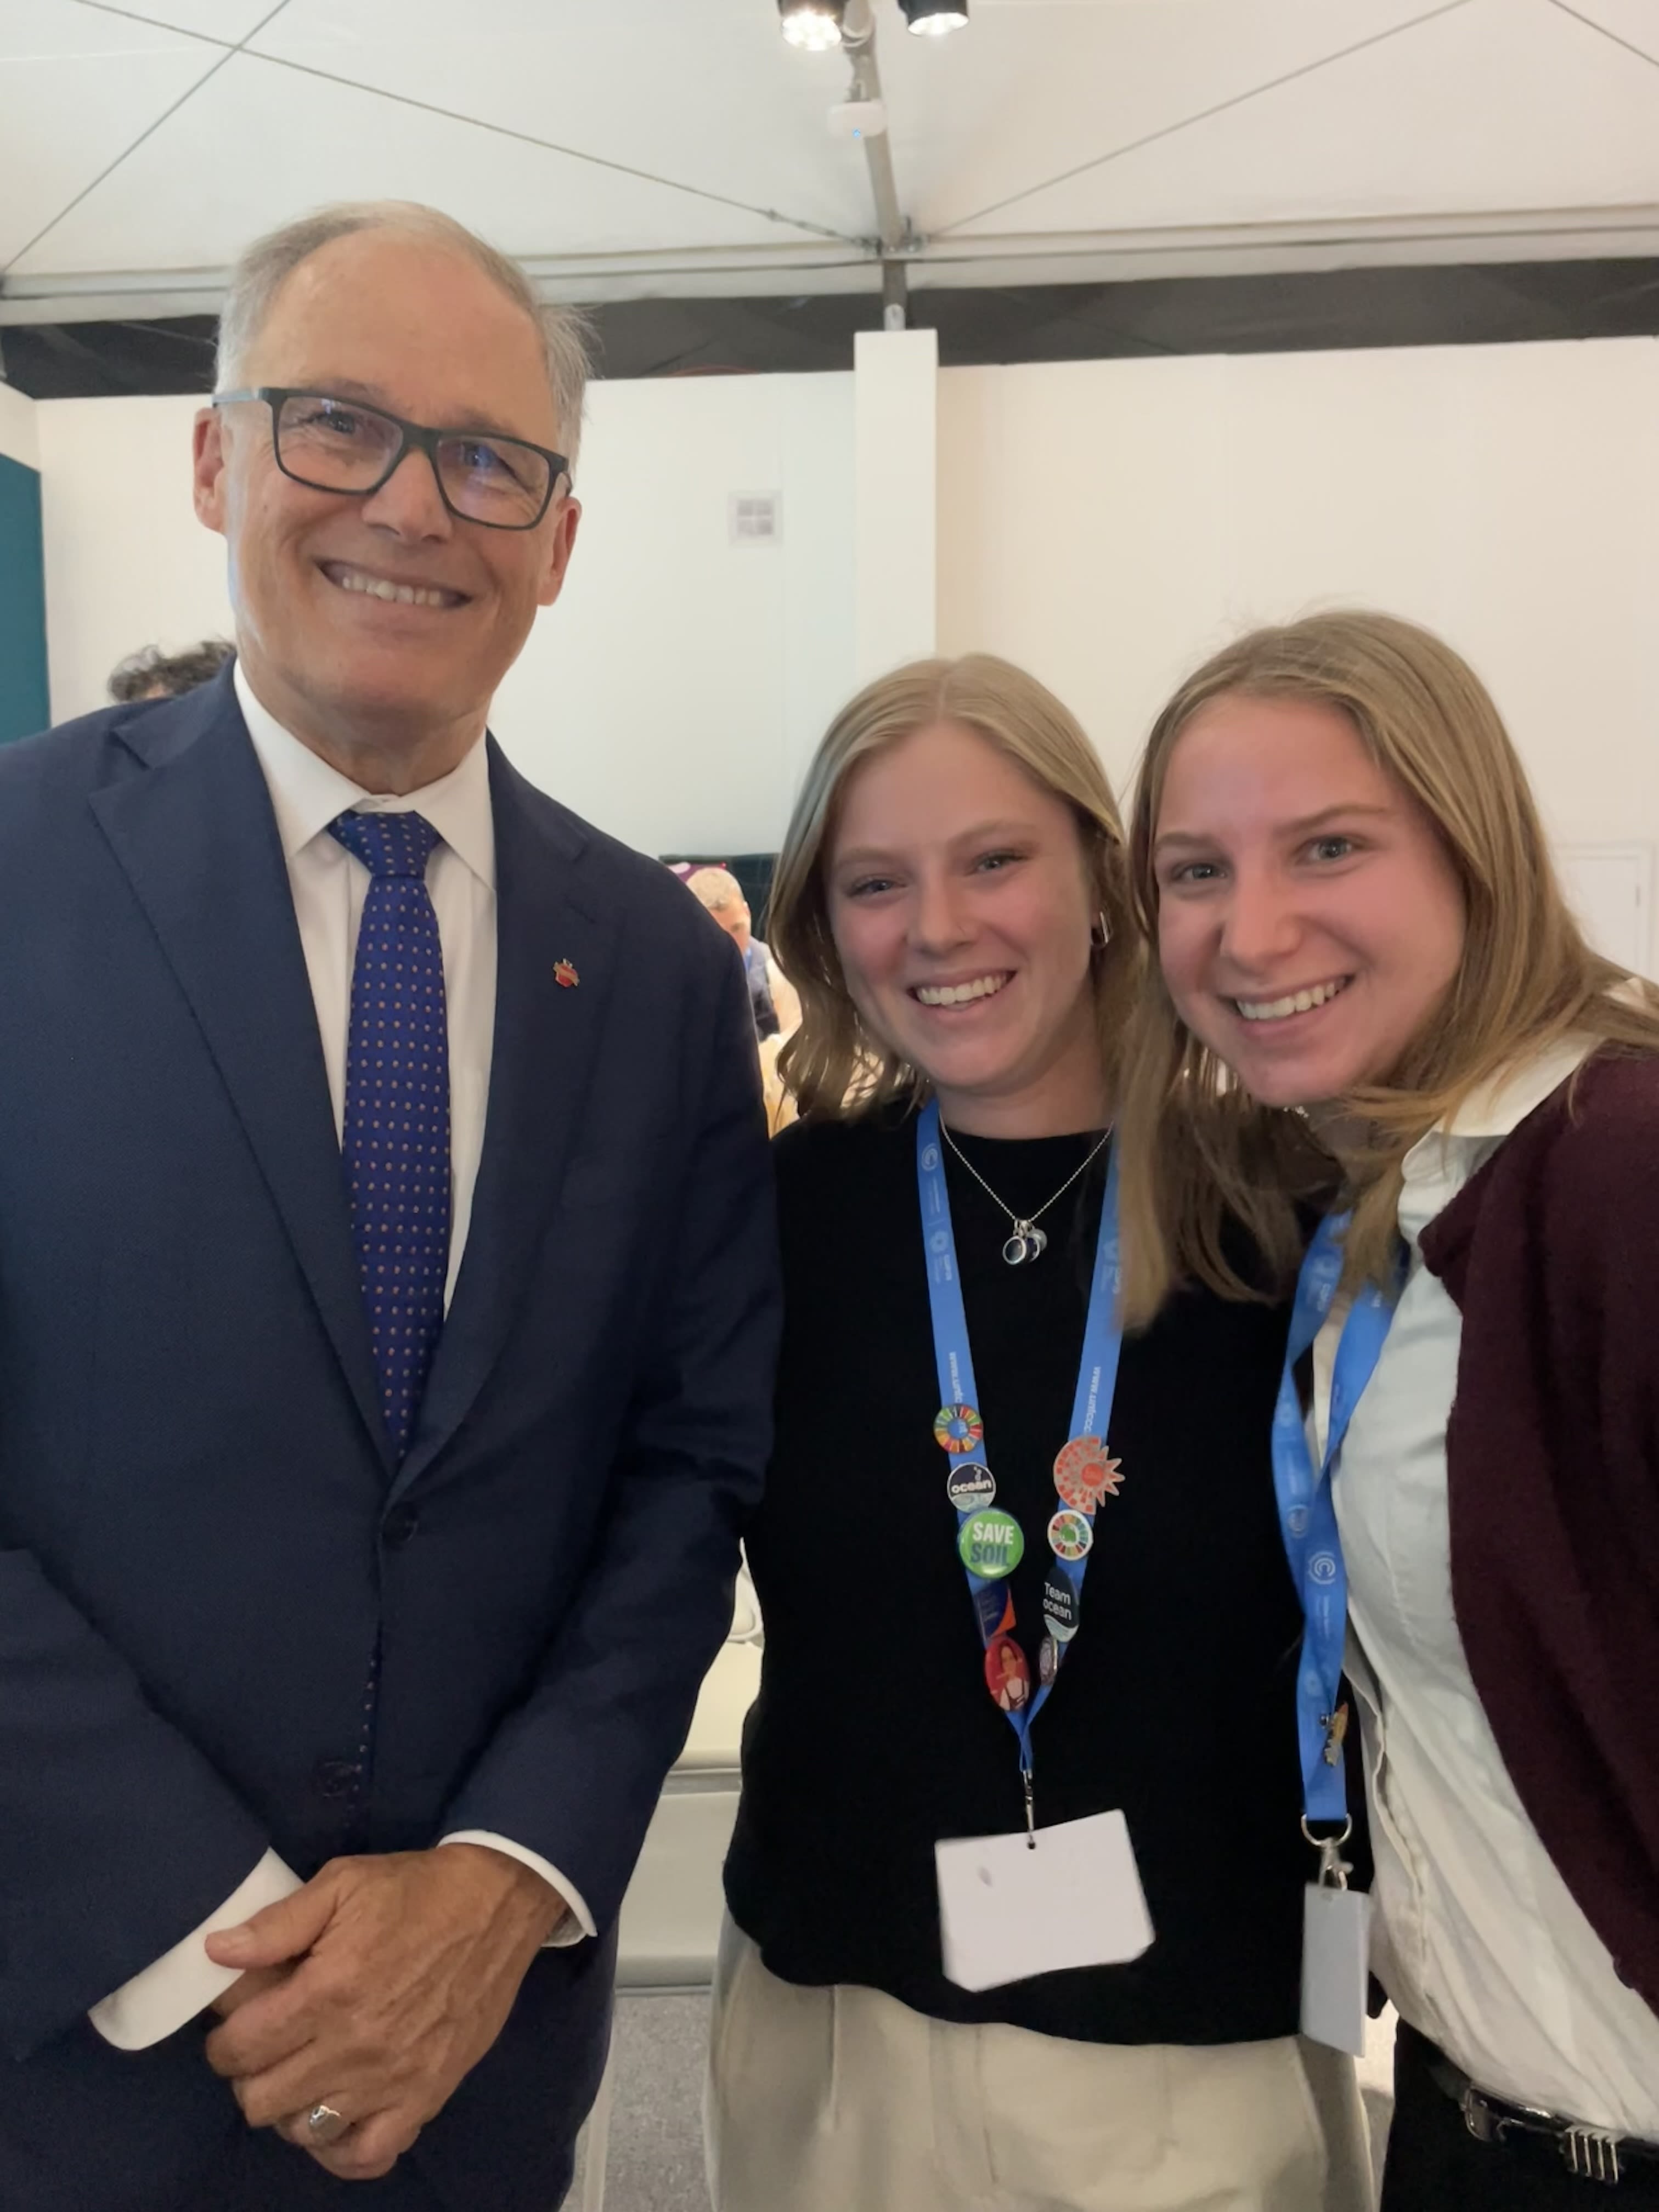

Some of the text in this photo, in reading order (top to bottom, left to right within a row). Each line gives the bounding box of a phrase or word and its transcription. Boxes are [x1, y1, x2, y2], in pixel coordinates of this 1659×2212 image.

[951, 1480, 992, 1494] ocean
[972, 1521, 1014, 1545] SAVE
[970, 1543, 1008, 1567] SOIL
[1044, 1582, 1071, 1605] Team
[1043, 1599, 1072, 1621] ocean
